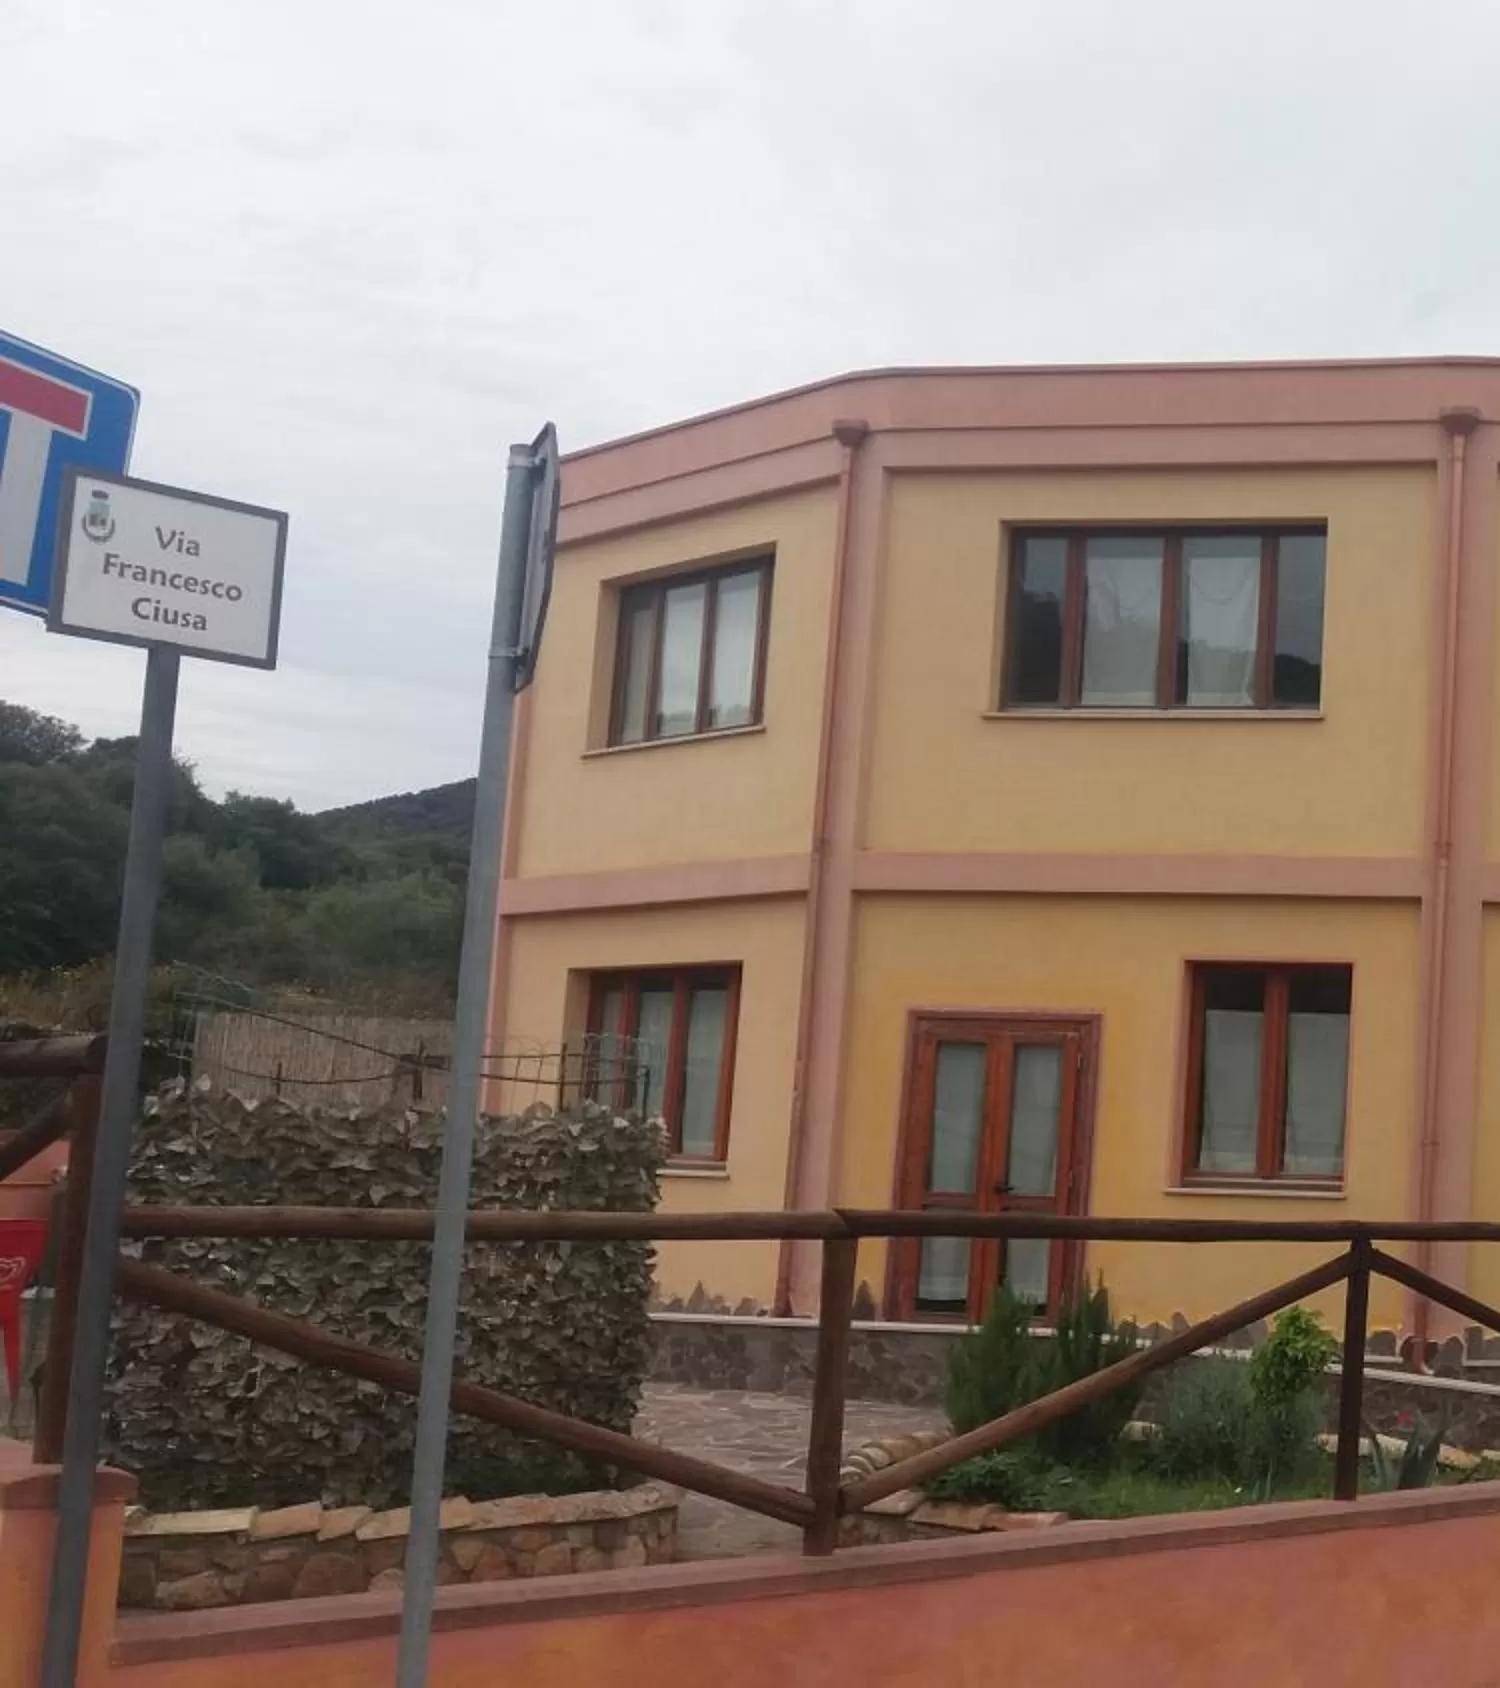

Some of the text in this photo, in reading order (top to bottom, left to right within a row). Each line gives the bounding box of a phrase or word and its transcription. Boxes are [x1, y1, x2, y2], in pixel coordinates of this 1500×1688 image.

[155, 526, 201, 556] Via
[103, 552, 243, 601] Francesco
[131, 597, 208, 631] Ciusa
